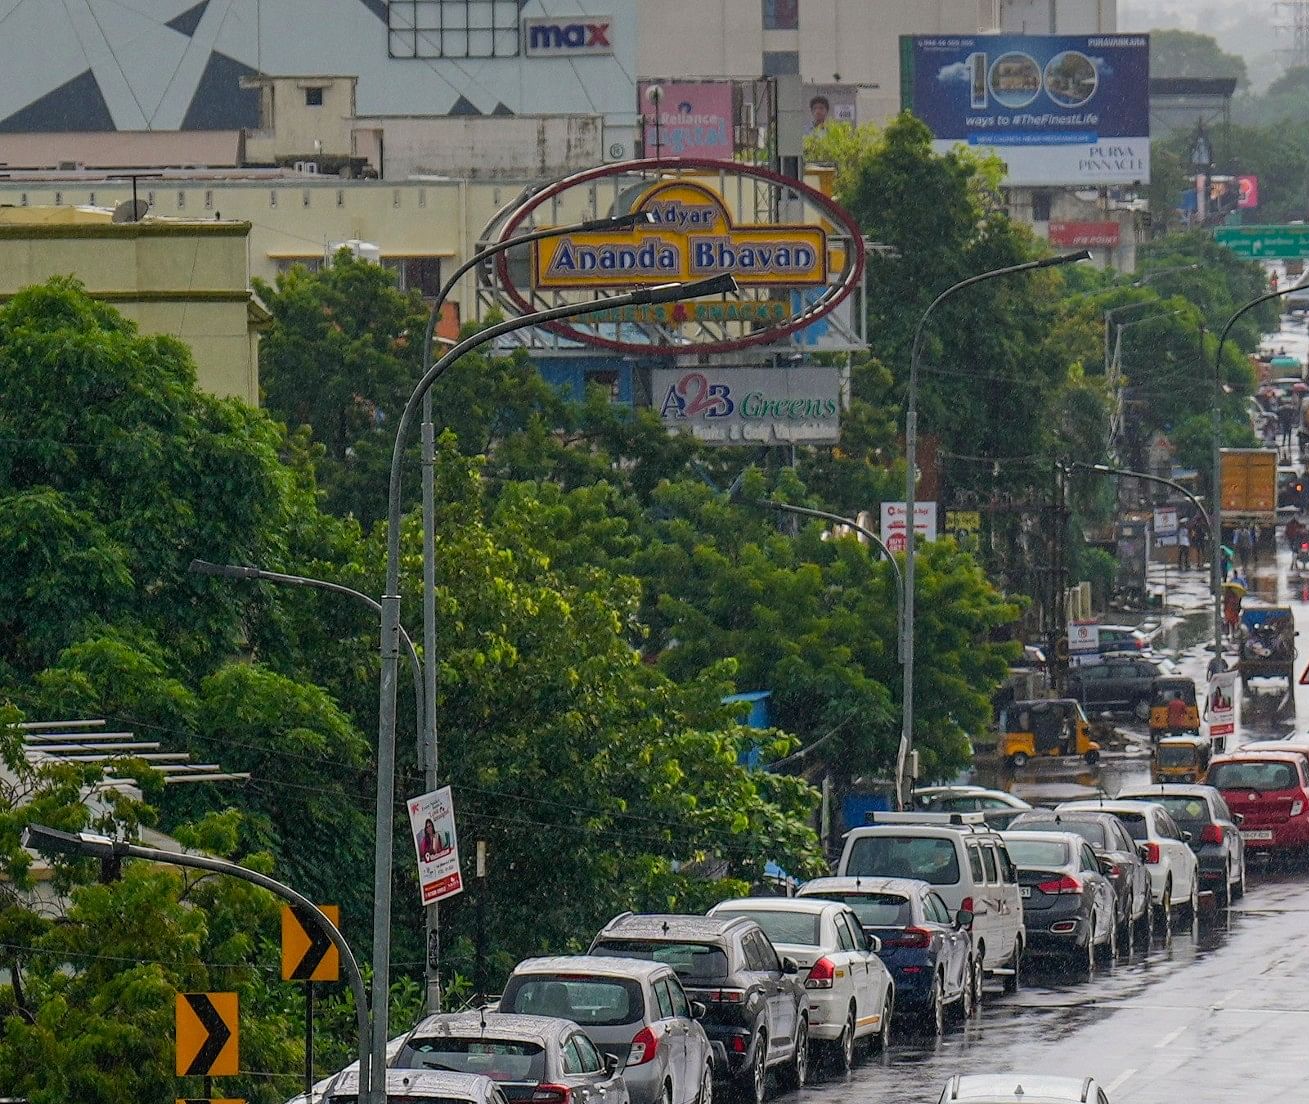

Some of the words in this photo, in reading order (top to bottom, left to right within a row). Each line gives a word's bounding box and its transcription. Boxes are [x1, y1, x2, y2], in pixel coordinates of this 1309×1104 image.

[530, 23, 610, 48] max
[965, 51, 1099, 109] 100
[966, 116, 994, 127] ways
[998, 115, 1009, 126] to
[1013, 114, 1098, 126] #TheFinestLife
[652, 204, 713, 232] Adyar
[554, 238, 677, 271] Ananda
[694, 240, 816, 270] Bhavan
[660, 373, 734, 419] A2B
[740, 393, 837, 419] Greens
